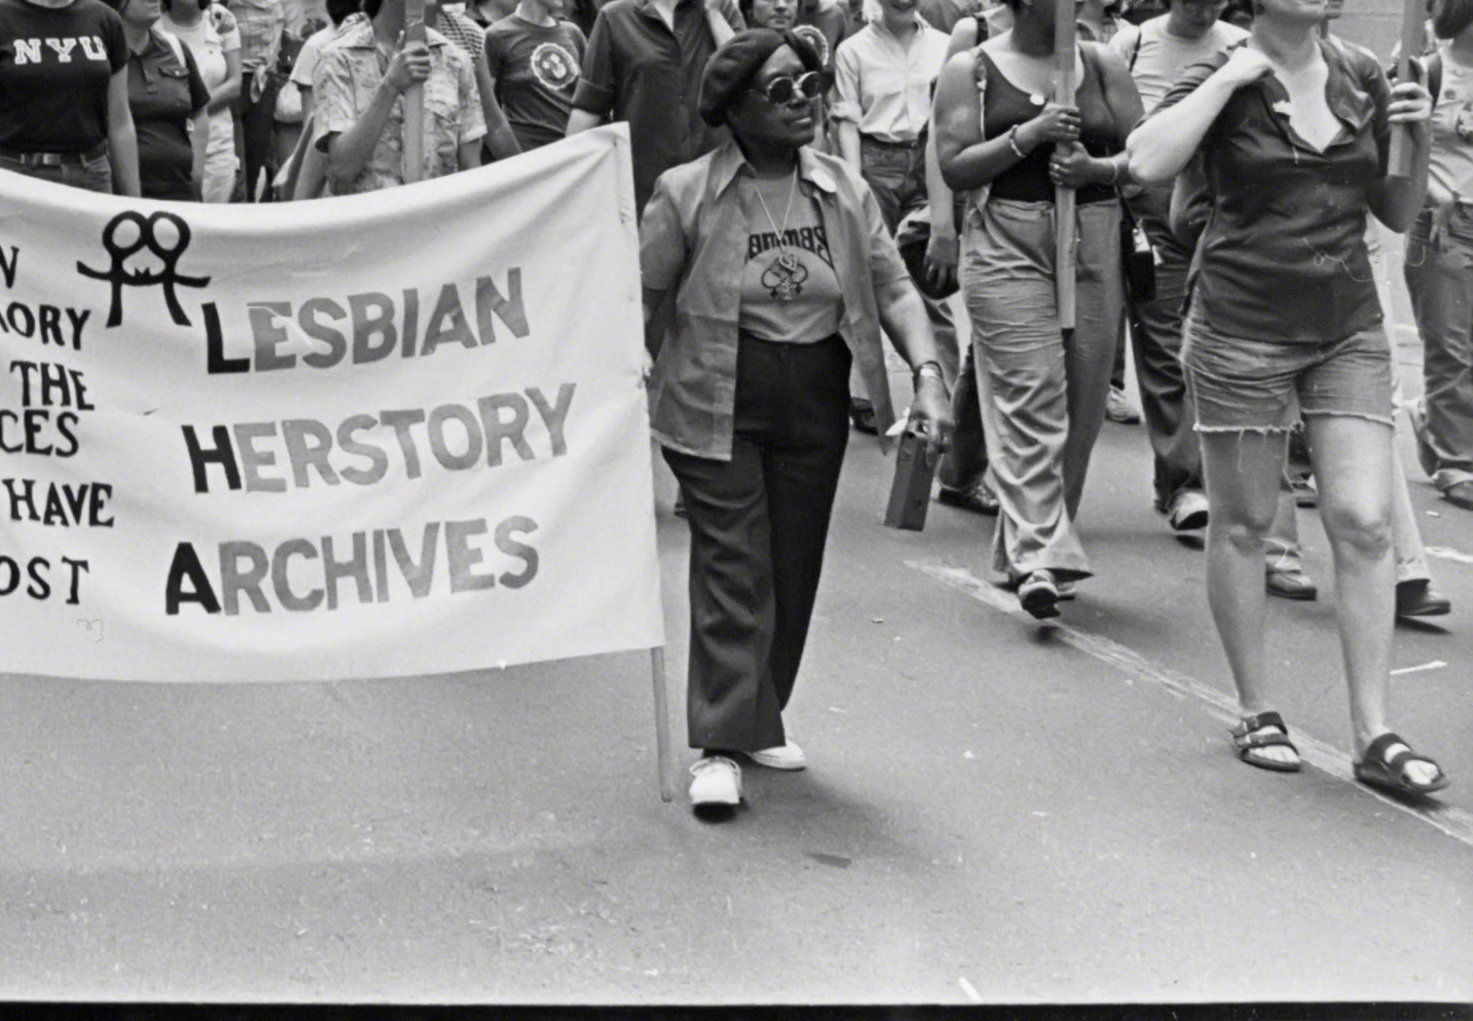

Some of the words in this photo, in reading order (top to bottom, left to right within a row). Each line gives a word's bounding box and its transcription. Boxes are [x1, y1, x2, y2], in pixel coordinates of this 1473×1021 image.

[13, 35, 107, 65] NYU
[201, 267, 530, 374] LESBIAN
[10, 360, 95, 411] THE
[181, 383, 577, 493] HERSTORY
[2, 478, 115, 528] HAVE
[165, 515, 539, 615] ARCHIVES
